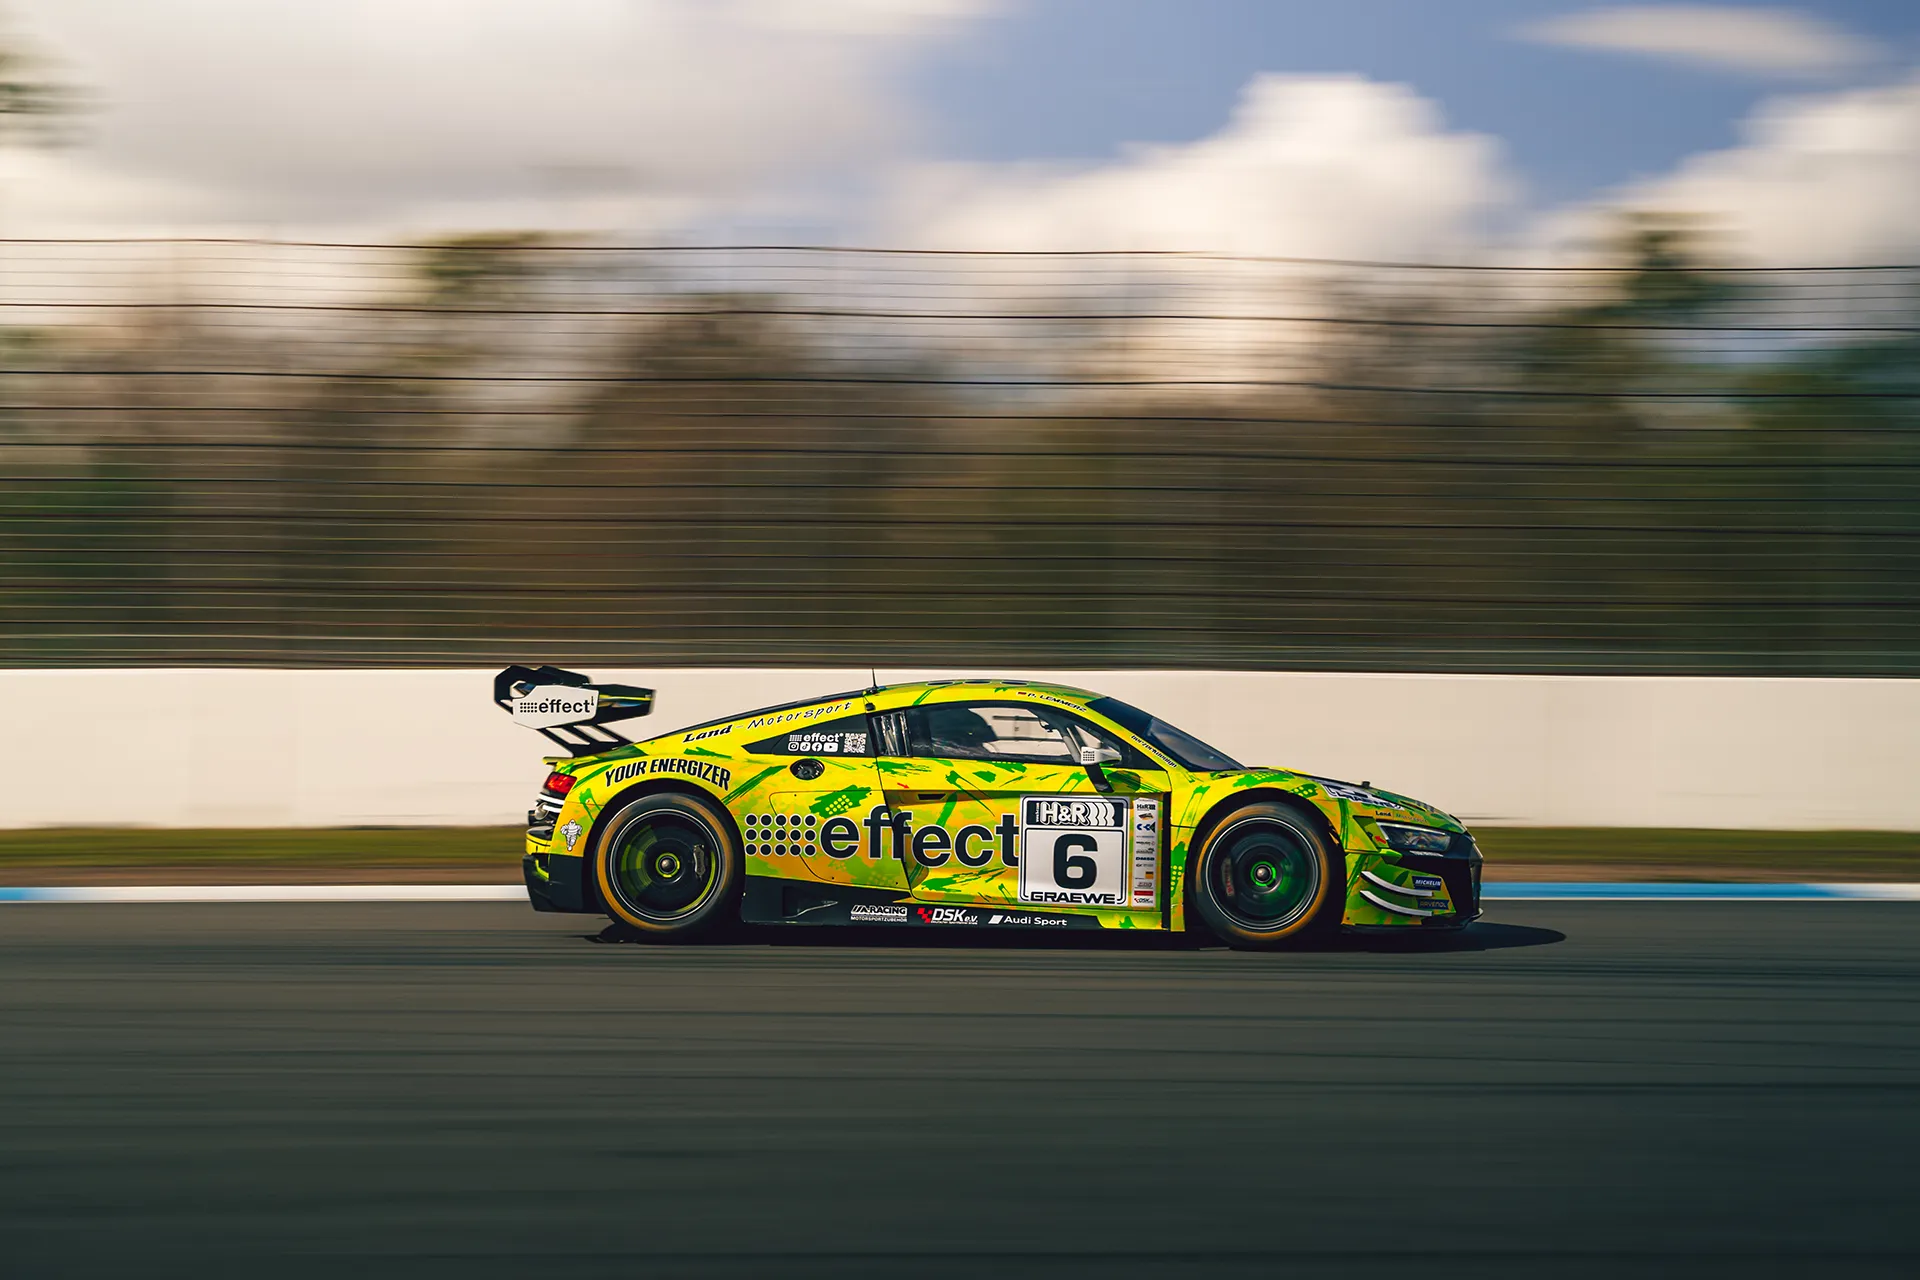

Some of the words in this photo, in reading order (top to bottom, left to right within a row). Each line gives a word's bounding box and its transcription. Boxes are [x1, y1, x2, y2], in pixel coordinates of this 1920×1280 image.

[540, 699, 590, 713] effect
[682, 724, 733, 743] Land
[747, 701, 852, 730] Motorsport
[803, 733, 840, 743] effect
[605, 761, 647, 787] YOUR
[650, 758, 731, 791] ENERGIZER
[1040, 801, 1092, 826] H&R
[820, 805, 1019, 867] effect
[1053, 833, 1099, 890] 6
[1030, 891, 1116, 904] GRAEWE
[932, 908, 967, 922] DSK
[1003, 915, 1031, 925] Audi
[1034, 916, 1067, 926] Sport
